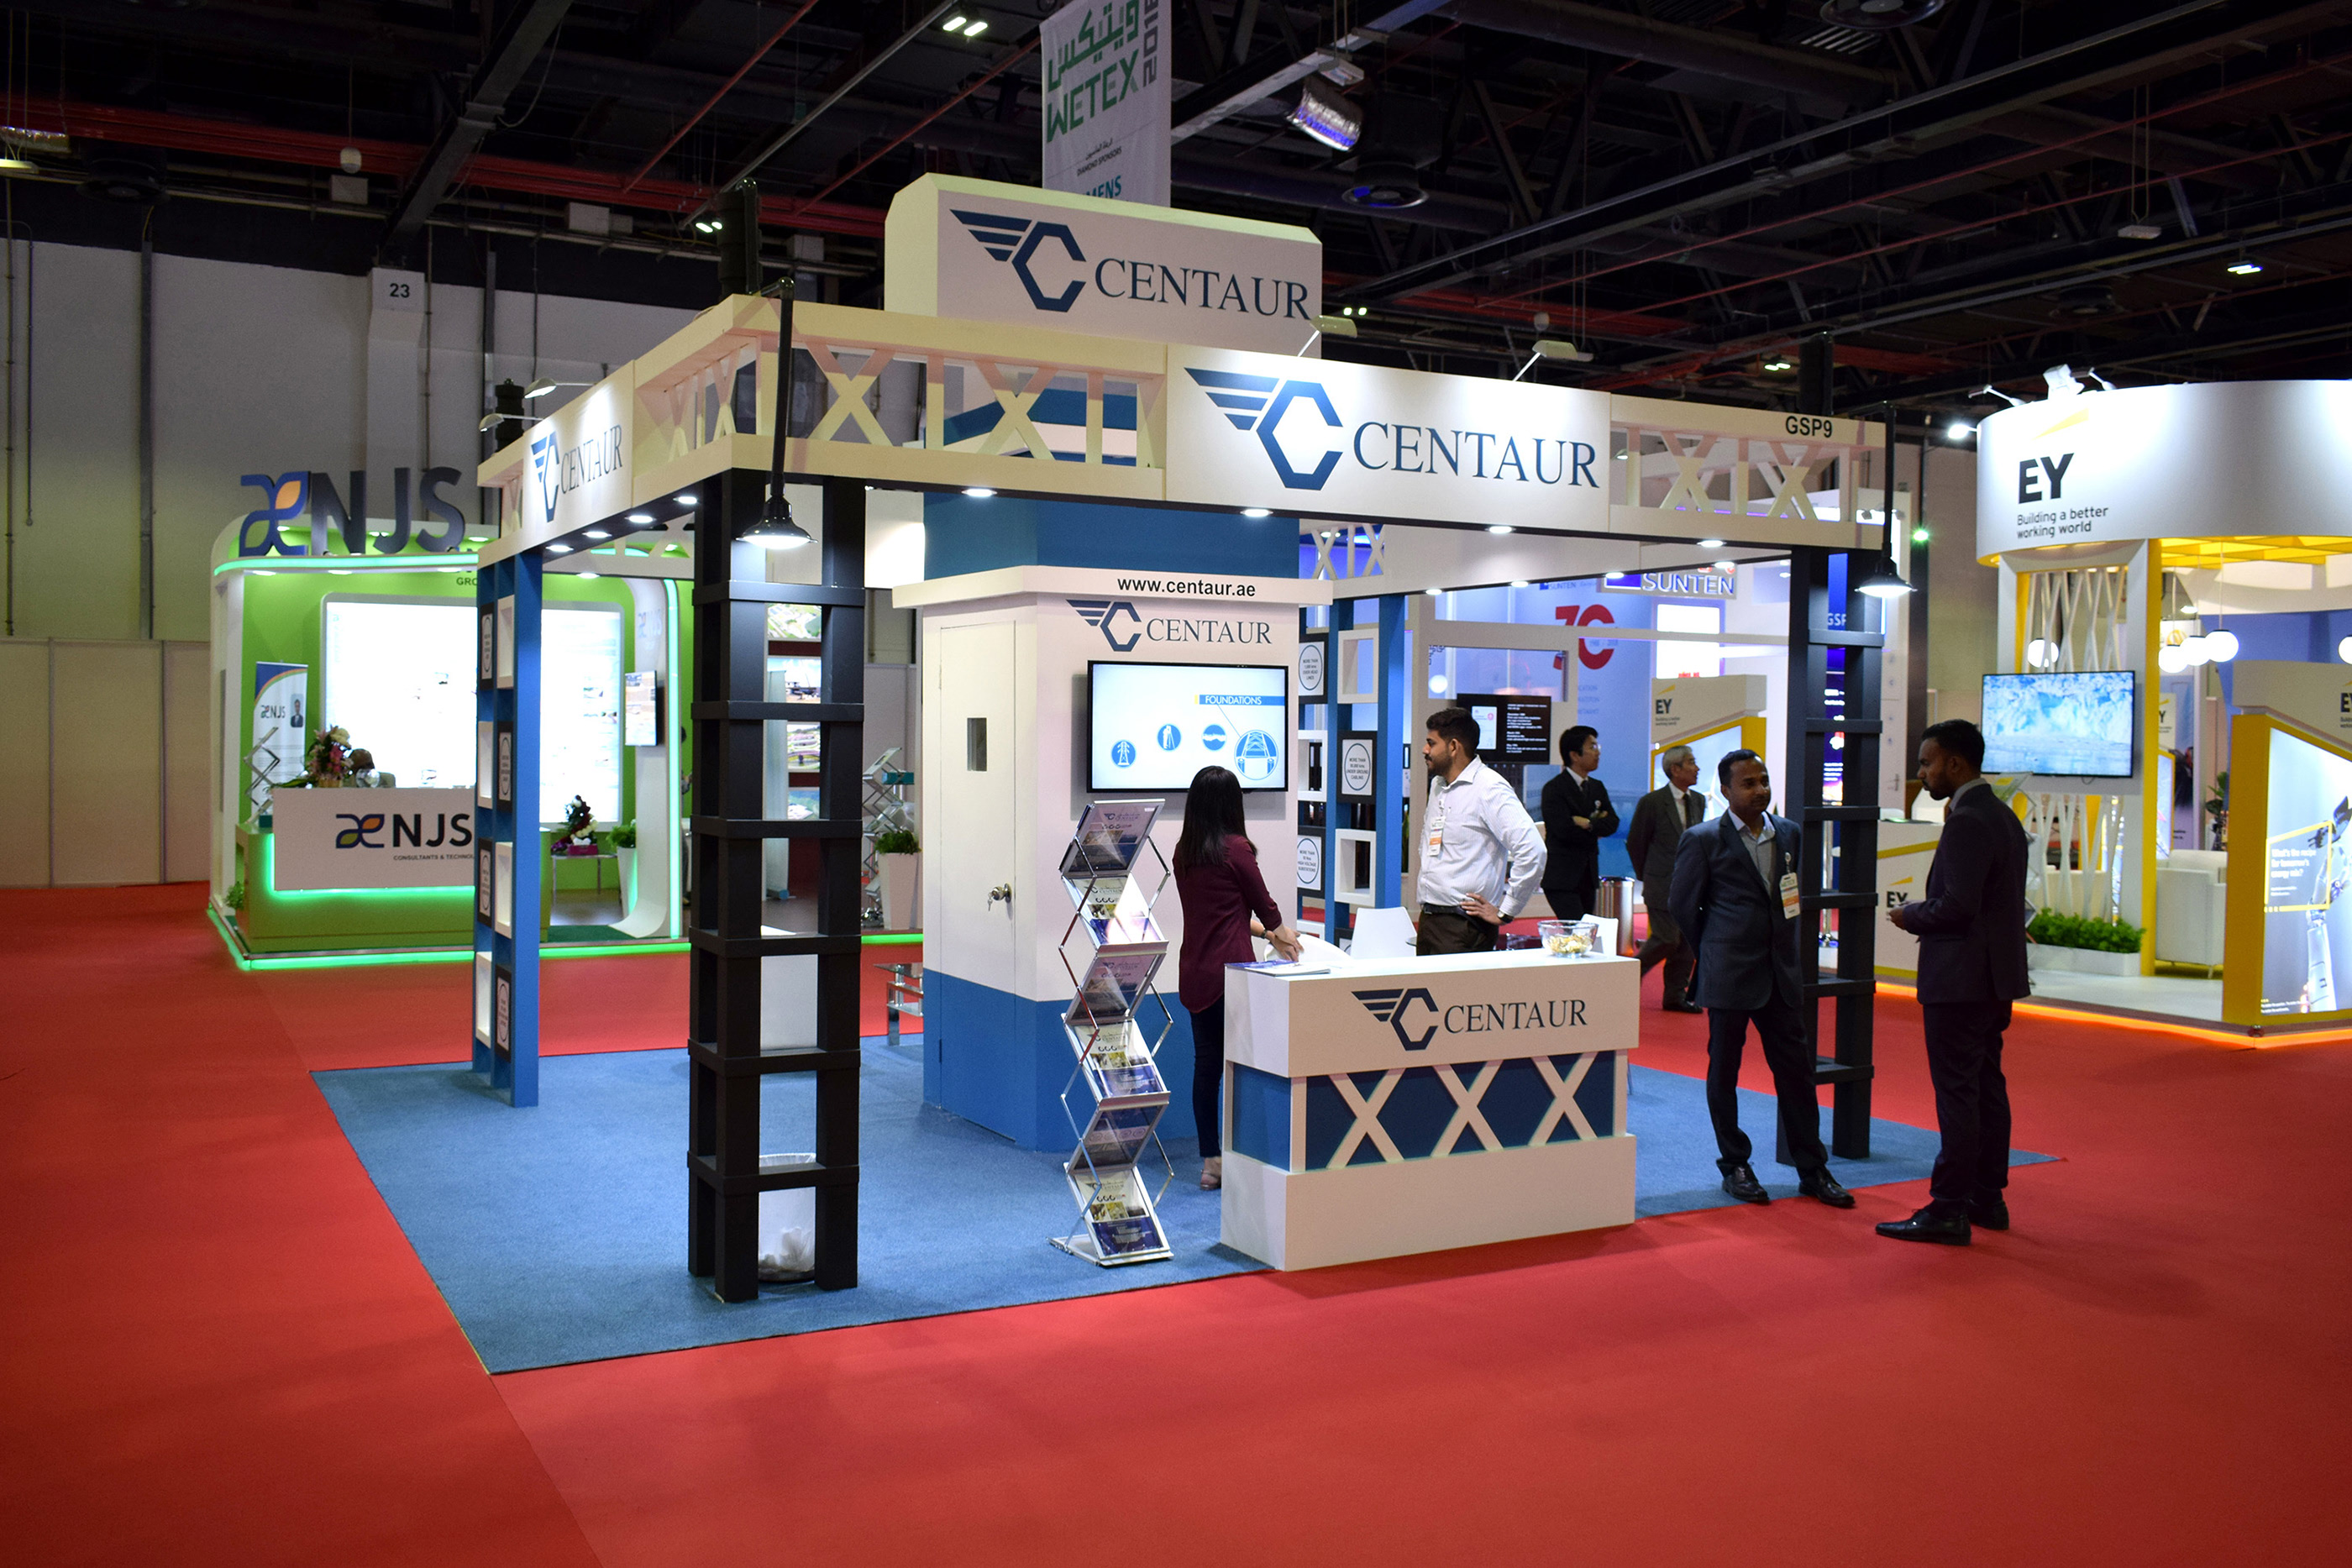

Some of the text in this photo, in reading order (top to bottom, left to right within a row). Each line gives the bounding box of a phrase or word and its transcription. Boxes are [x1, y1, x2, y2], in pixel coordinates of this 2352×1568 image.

[1047, 49, 1139, 144] WETEX
[390, 282, 410, 298] 23
[1095, 257, 1311, 321] CENTAUR
[1785, 415, 1833, 438] GSP9
[560, 424, 623, 495] CENTAUR
[1353, 421, 1600, 489] CENTAUR
[2018, 452, 2075, 504] EY
[311, 466, 466, 556] NJS
[2017, 506, 2109, 526] Building a better
[2017, 521, 2092, 538] working world
[1116, 578, 1257, 598] www.centaur.ae
[1641, 573, 1735, 595] SUNTEN
[1146, 617, 1273, 645] CENTAUR
[1205, 695, 1263, 705] FOUNDATIONS
[1656, 698, 1673, 715] EY
[393, 813, 473, 847] NJS
[1443, 999, 1588, 1034] CENTAUR
